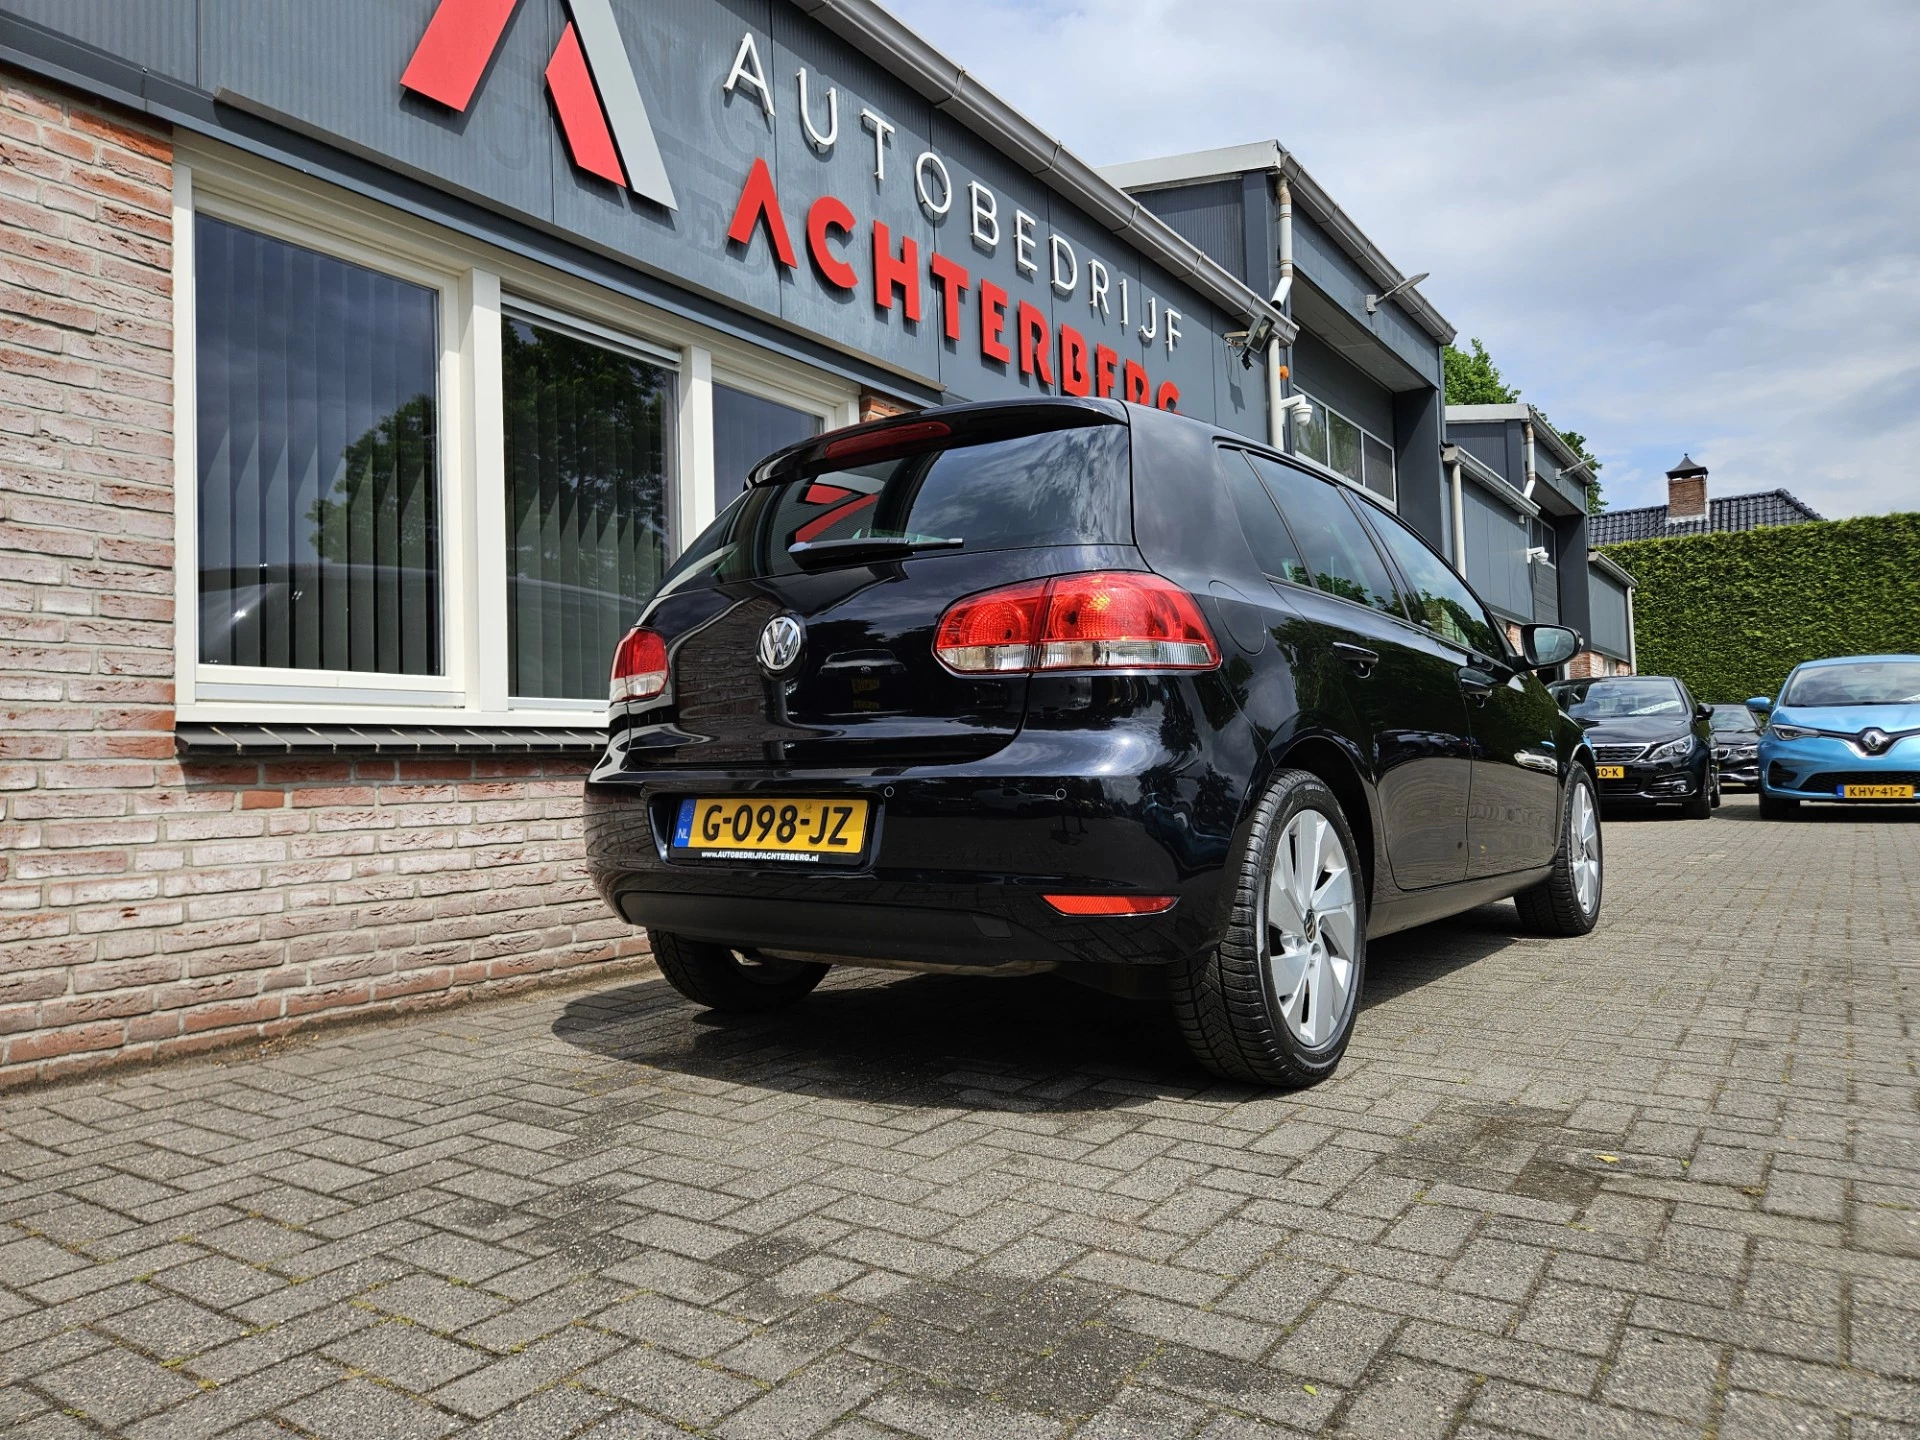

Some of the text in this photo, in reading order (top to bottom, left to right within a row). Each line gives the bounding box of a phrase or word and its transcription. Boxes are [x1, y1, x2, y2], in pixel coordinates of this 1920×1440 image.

[723, 32, 1182, 352] AUTOBEDRIJF
[1849, 786, 1906, 797] KHV-41-Z
[702, 804, 853, 846] G-098-JZ
[677, 828, 688, 838] NL
[701, 850, 819, 862] www.AUTOBEDRIJFACHTERBERG.nl
